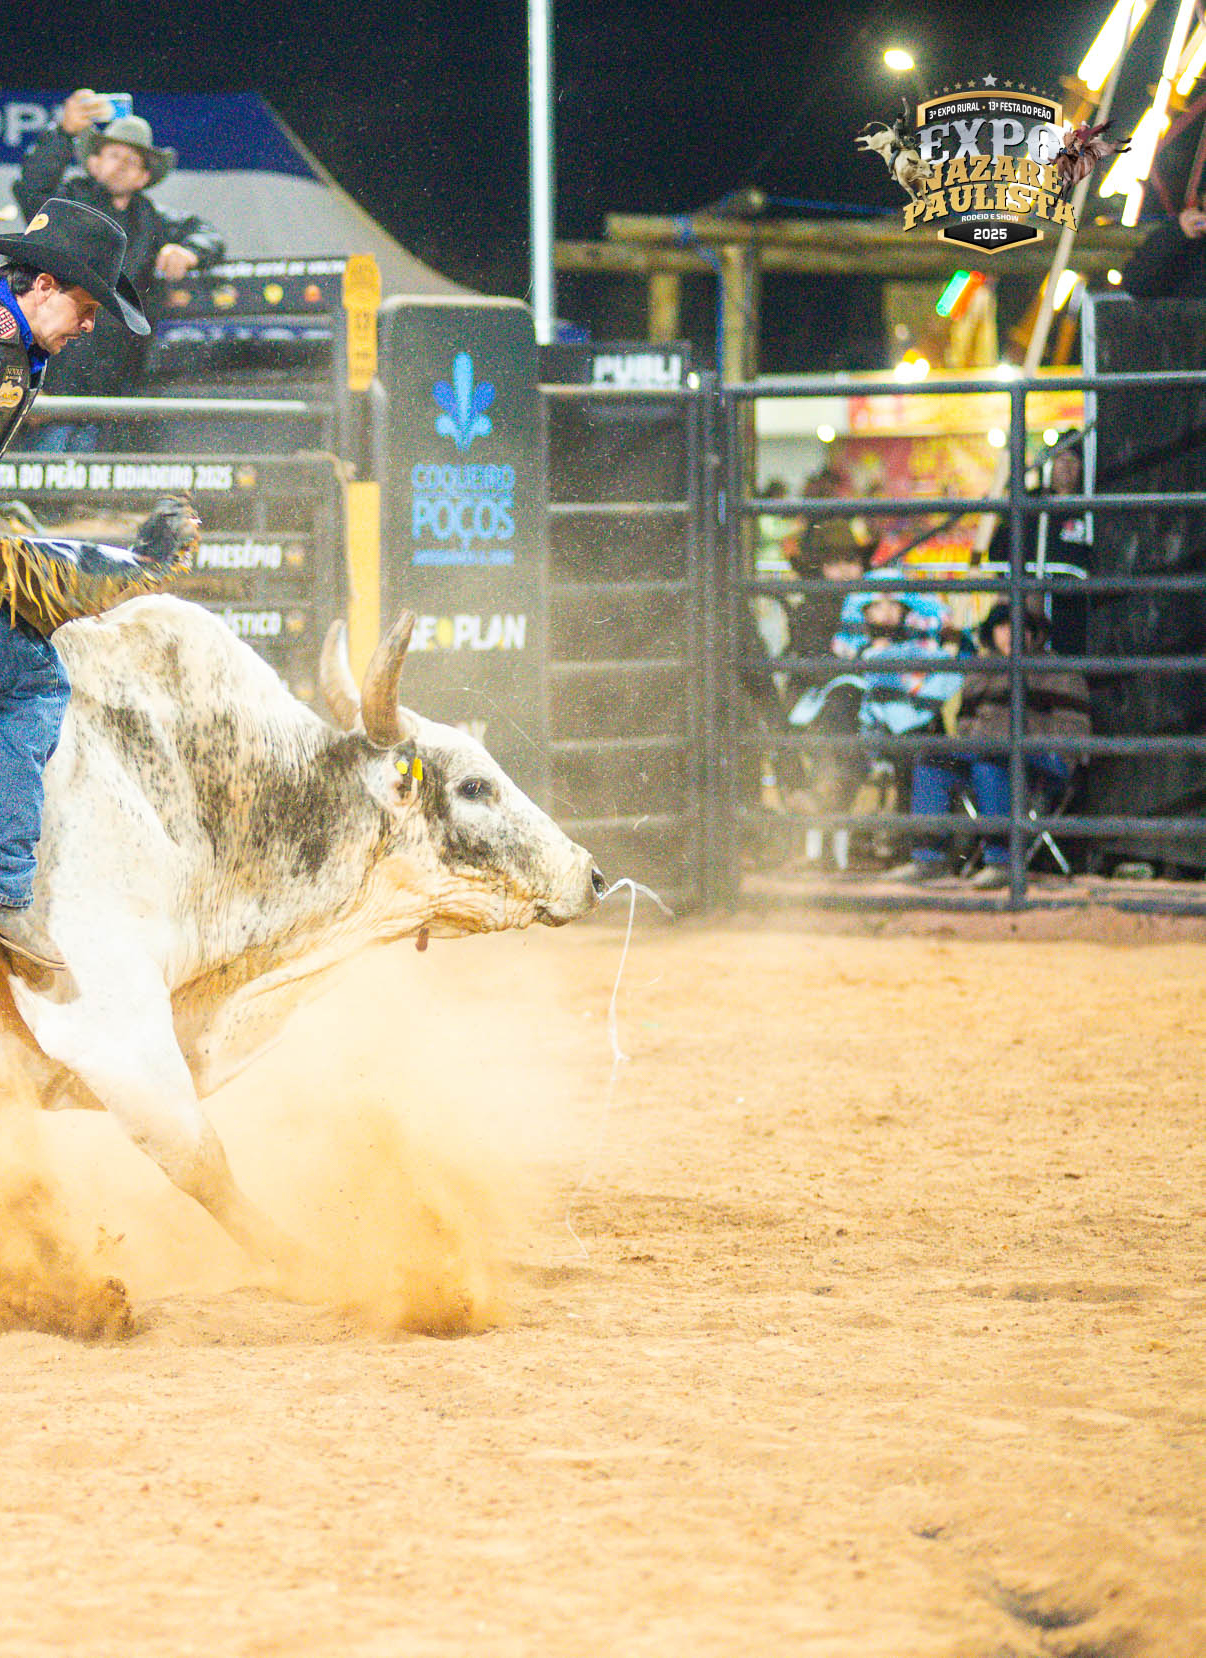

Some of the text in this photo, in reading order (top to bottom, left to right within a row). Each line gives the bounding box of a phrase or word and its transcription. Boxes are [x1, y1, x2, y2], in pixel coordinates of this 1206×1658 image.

[411, 463, 516, 493] COQUEIRO
[411, 497, 516, 550] POÇOS
[219, 608, 282, 637] ÍSTICO
